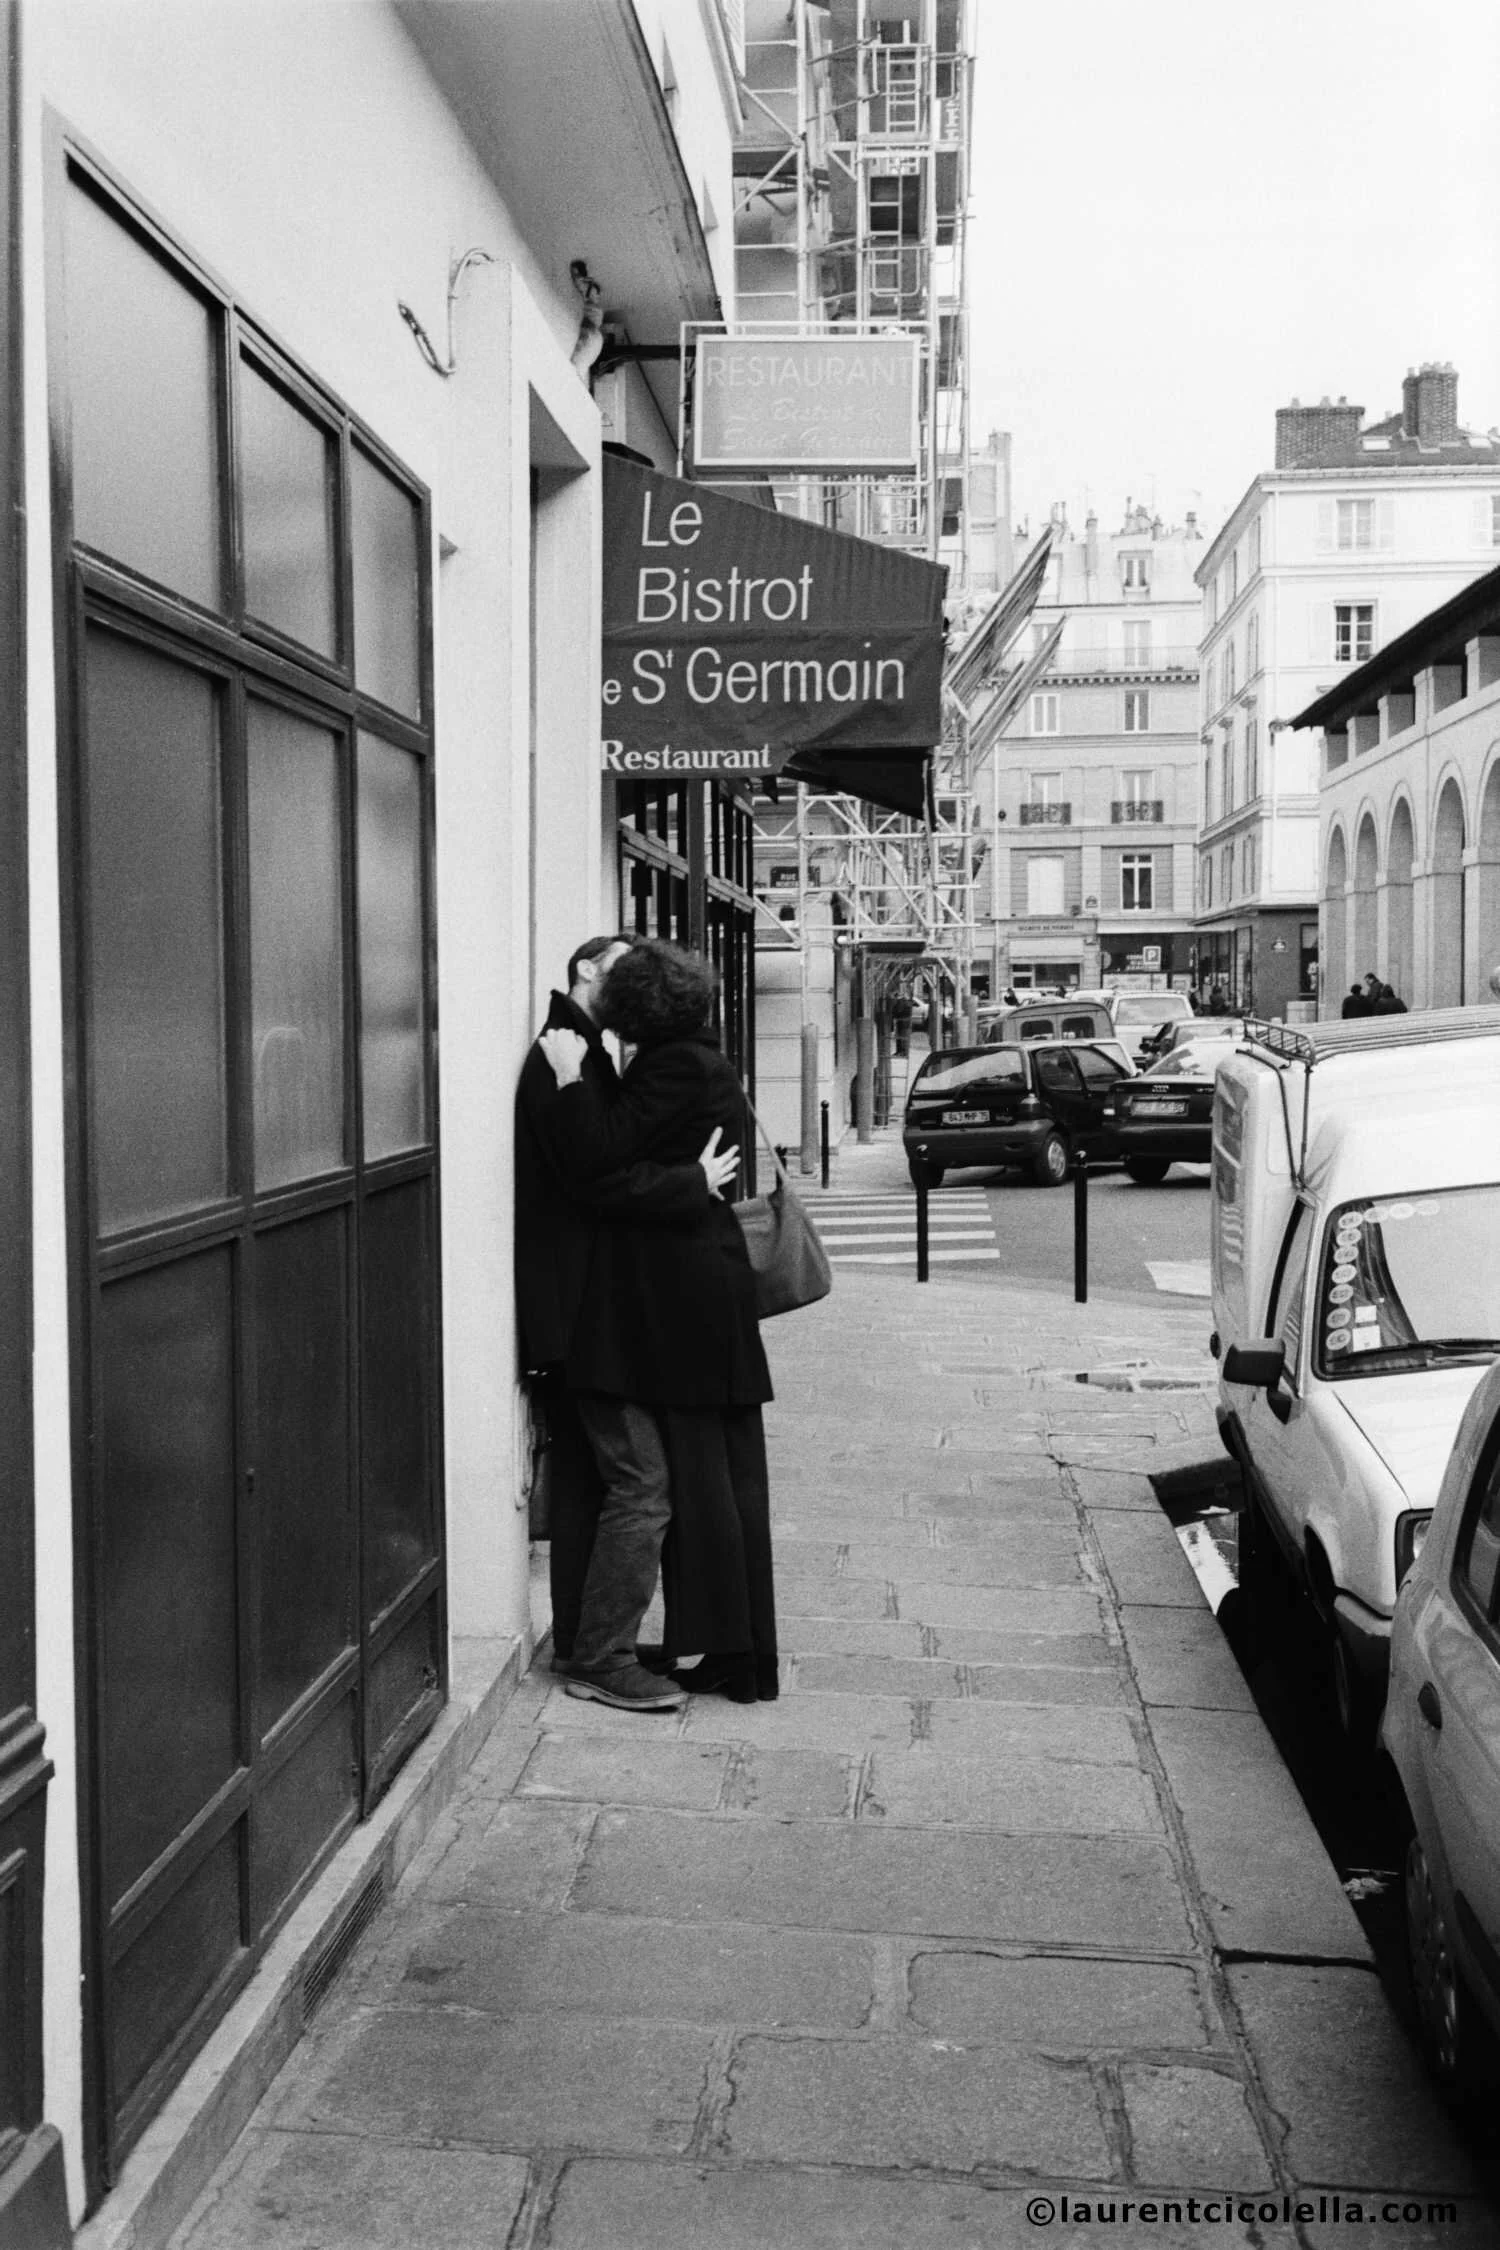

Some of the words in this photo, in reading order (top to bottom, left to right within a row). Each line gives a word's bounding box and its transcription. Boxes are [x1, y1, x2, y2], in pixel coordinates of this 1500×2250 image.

[706, 356, 912, 387] RESTAURANT
[642, 491, 702, 546] Le
[637, 565, 813, 622] Bistrot
[602, 679, 621, 704] e
[632, 649, 674, 704] St
[687, 642, 904, 703] Germain
[601, 739, 772, 771] Restaurant
[1147, 950, 1156, 961] P
